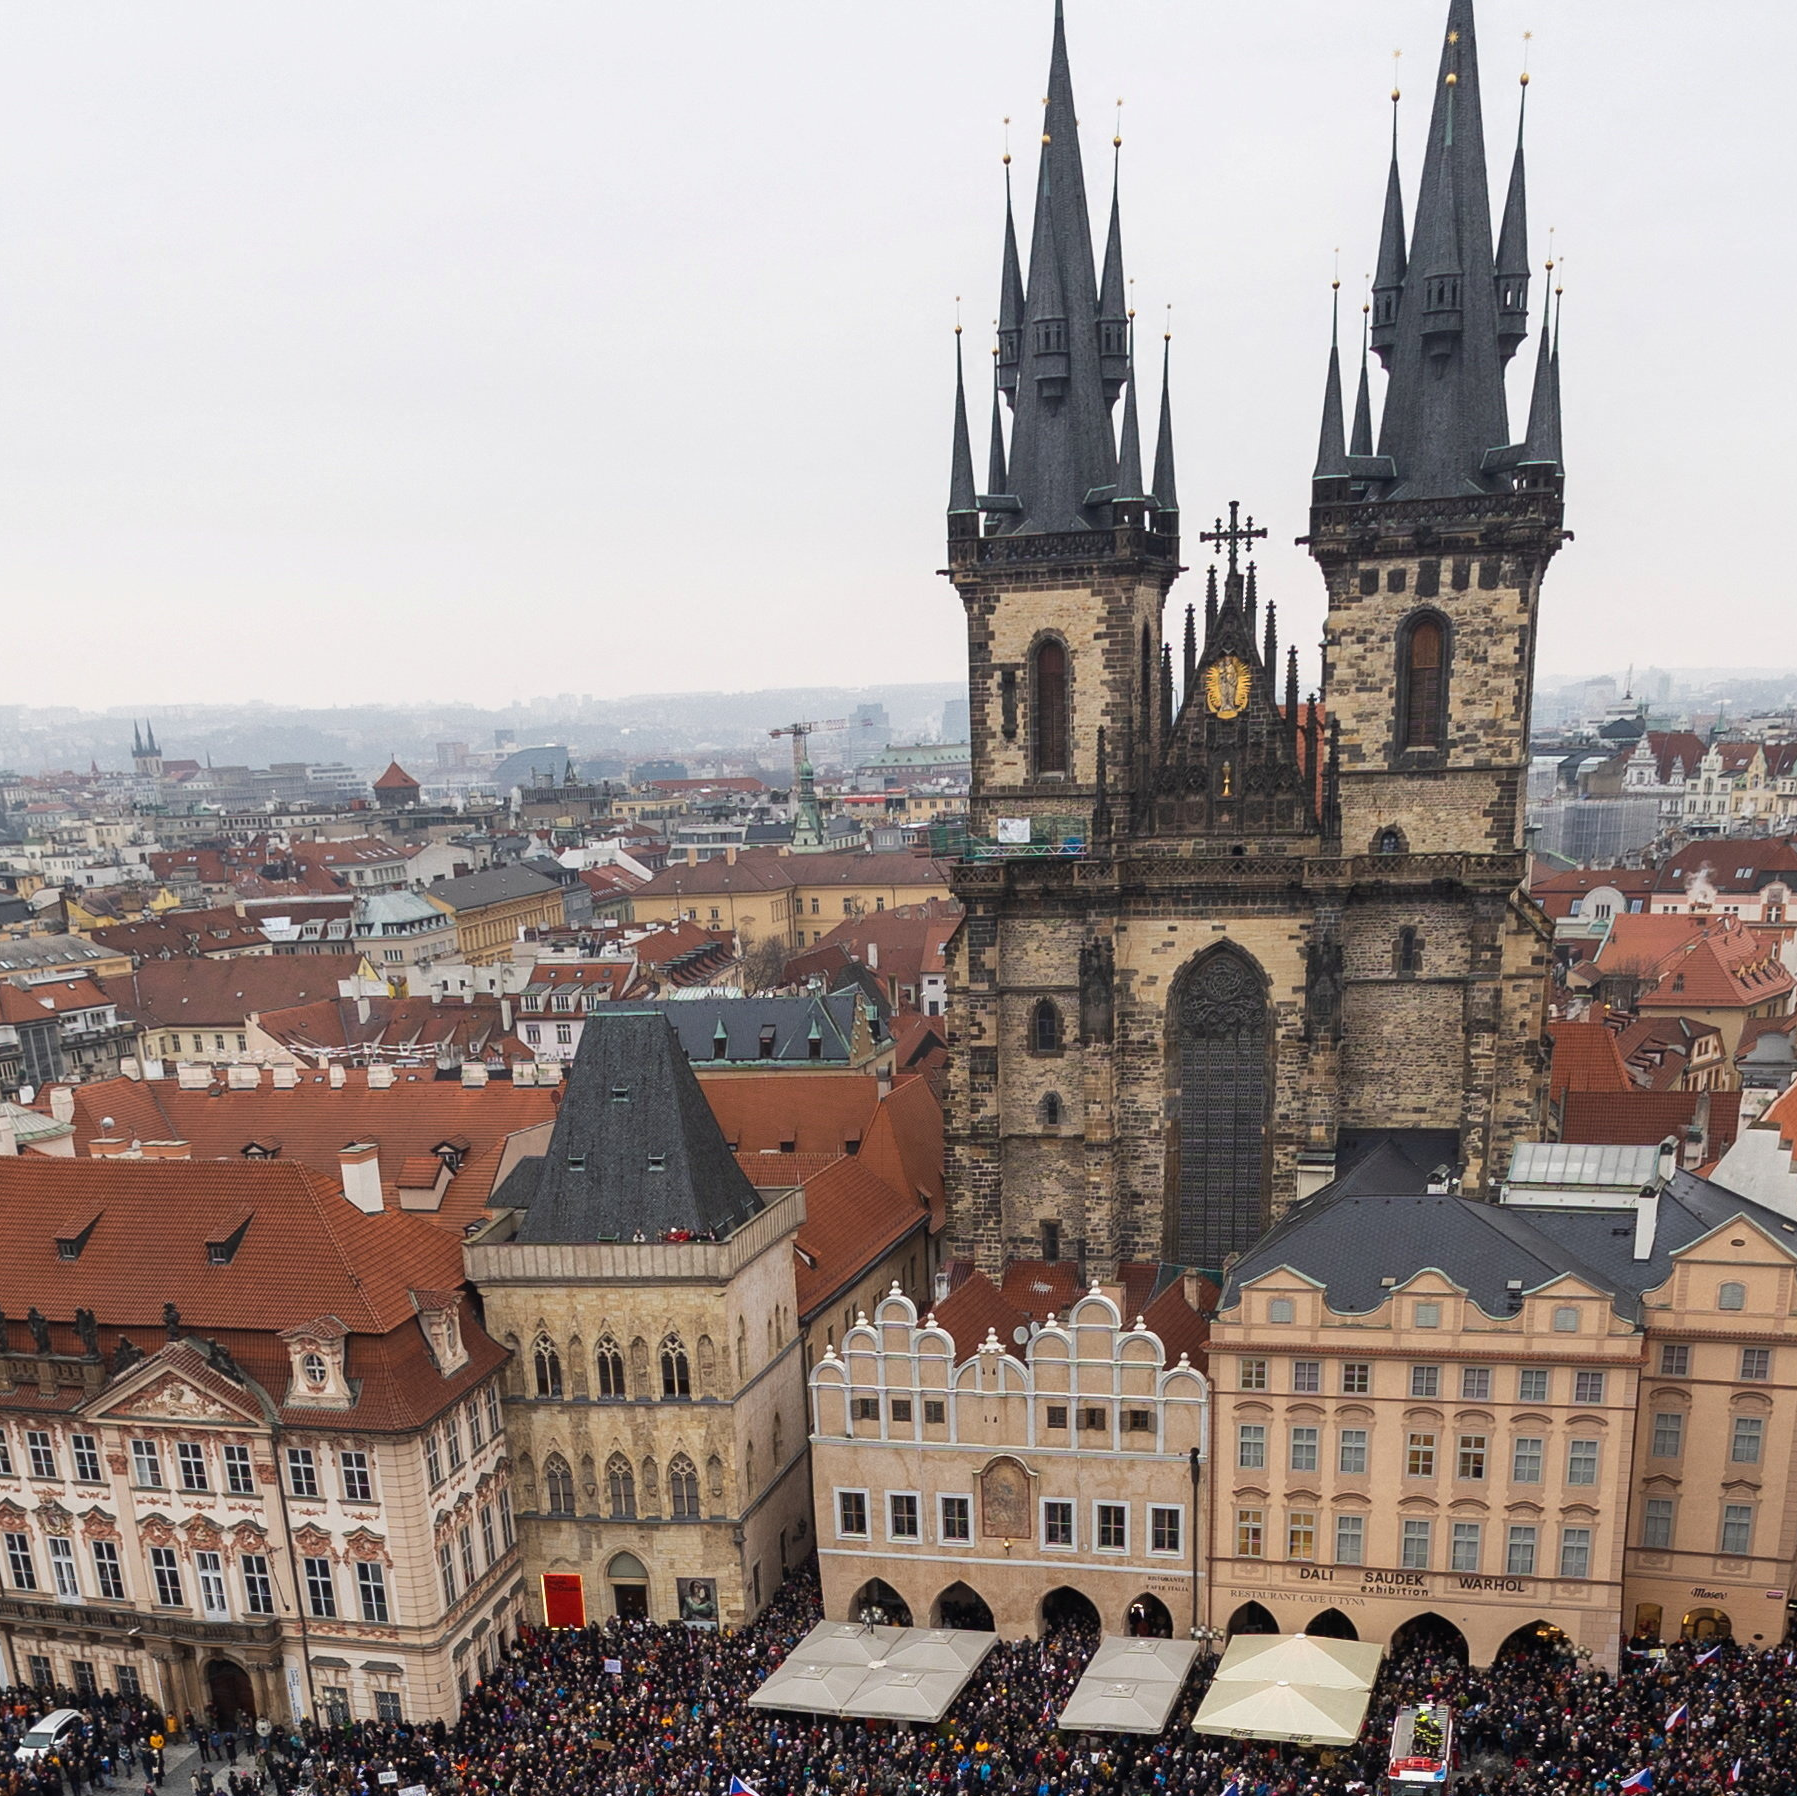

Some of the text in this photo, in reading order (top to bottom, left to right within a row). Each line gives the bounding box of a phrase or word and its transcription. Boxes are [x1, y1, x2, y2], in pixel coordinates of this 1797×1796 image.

[1364, 1571, 1425, 1586] SAUDEK
[1459, 1576, 1525, 1592] WARHOL
[1230, 1589, 1297, 1602] RESTAURANT
[1360, 1584, 1429, 1597] exhibition
